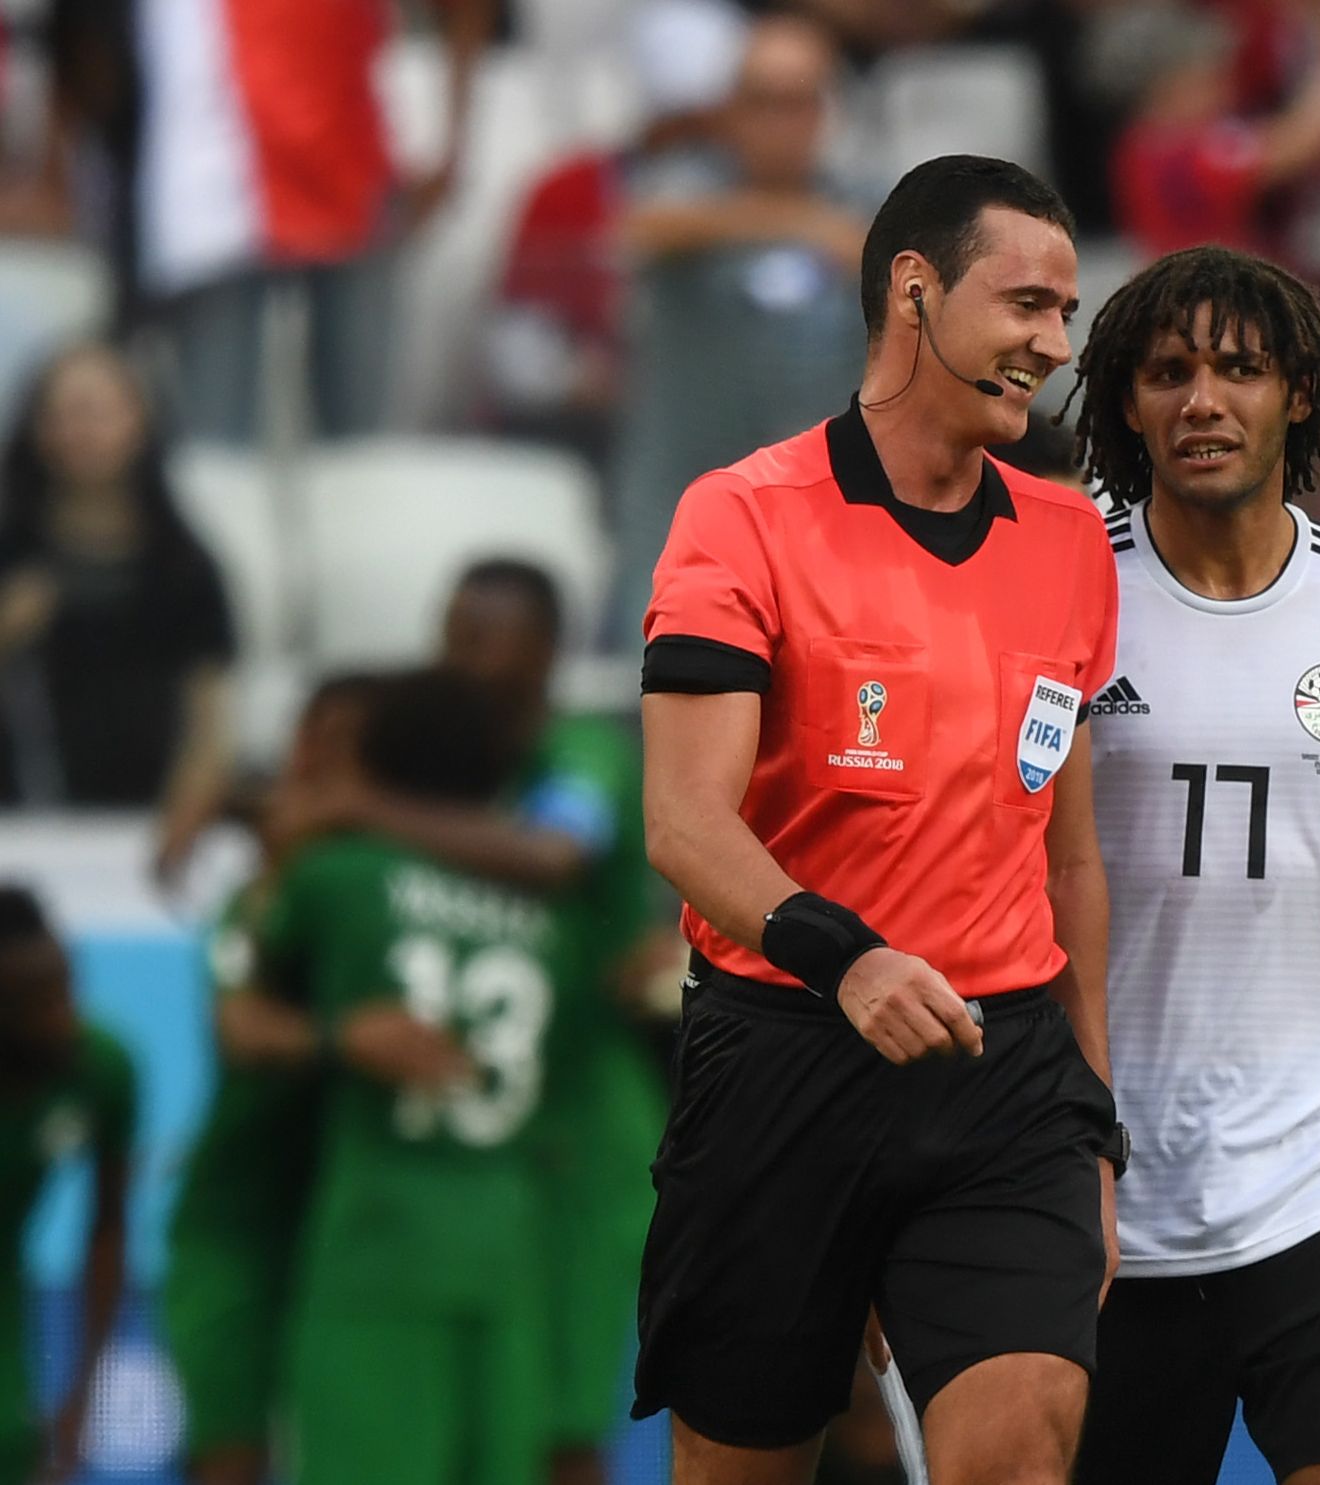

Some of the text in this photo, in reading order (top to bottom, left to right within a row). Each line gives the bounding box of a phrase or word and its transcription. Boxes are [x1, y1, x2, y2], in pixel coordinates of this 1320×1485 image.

[1035, 685, 1075, 711] REFEREE
[1090, 700, 1151, 716] adidas
[1025, 718, 1061, 752] FIFA
[828, 754, 904, 771] RUSSIA 2018
[1026, 767, 1044, 784] 2018
[1171, 763, 1270, 879] 17
[387, 936, 553, 1147] 13
